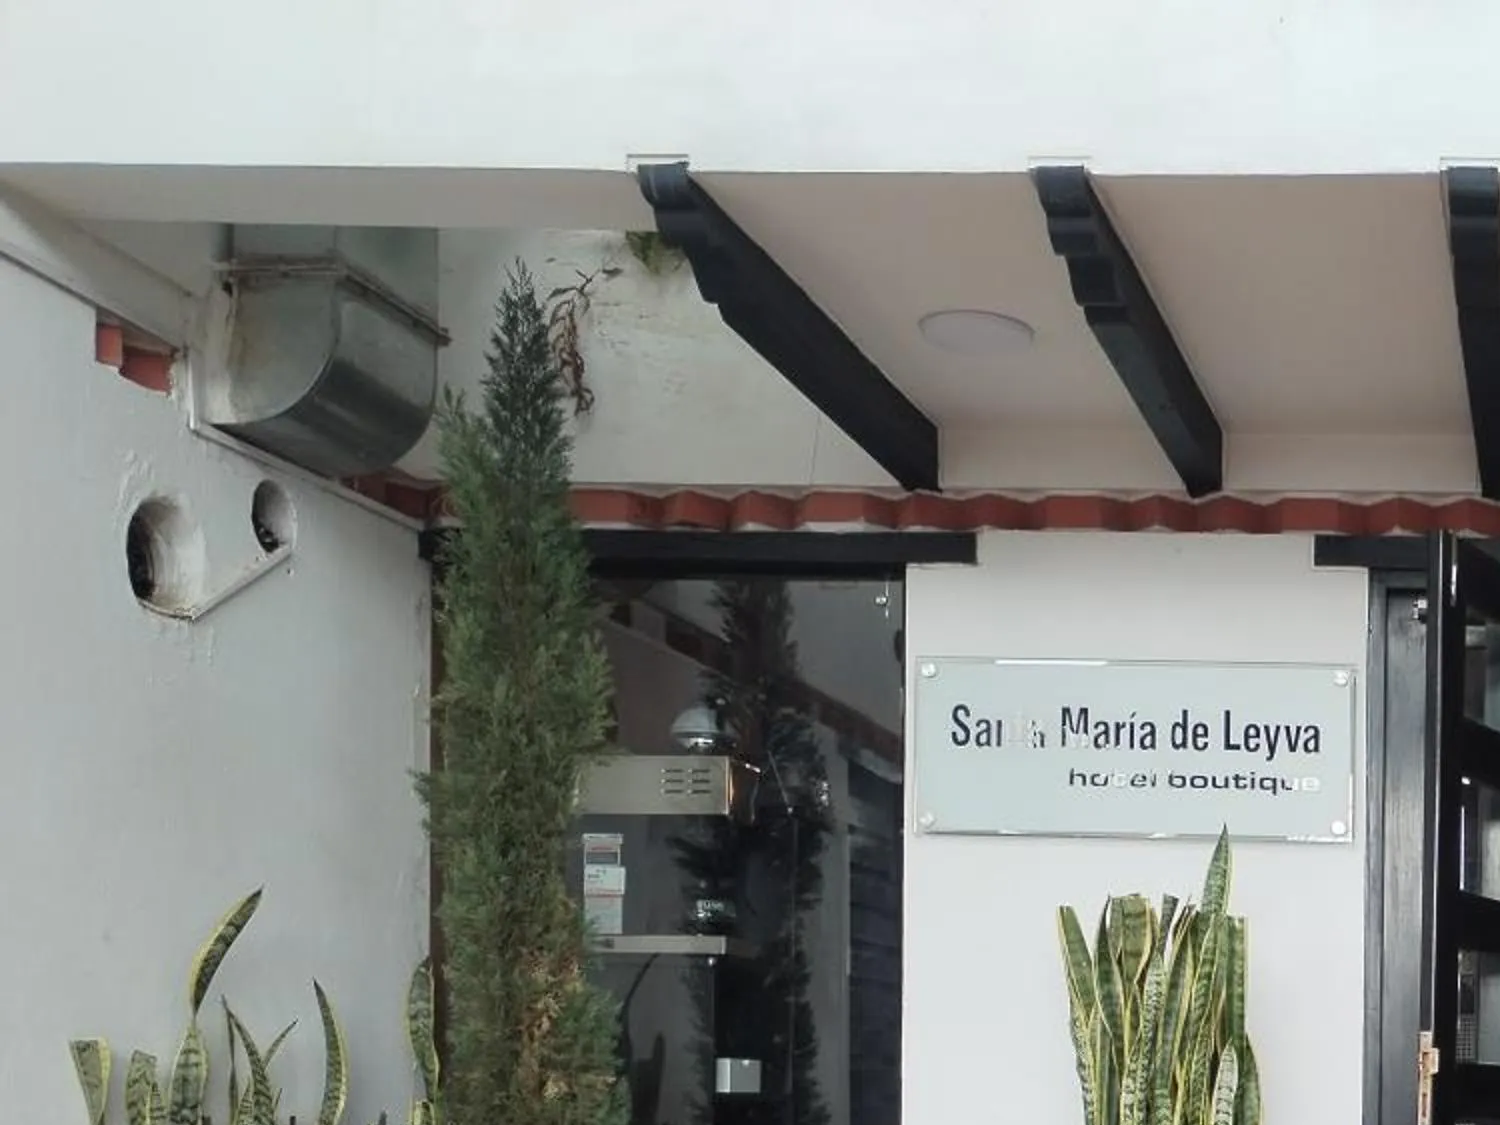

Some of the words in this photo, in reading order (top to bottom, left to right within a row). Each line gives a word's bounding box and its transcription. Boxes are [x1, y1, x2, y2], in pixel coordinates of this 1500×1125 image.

[951, 703, 1046, 749] Saa
[1060, 706, 1157, 750] María
[1171, 708, 1209, 751] de
[1224, 709, 1321, 762] Leyva
[1167, 770, 1321, 796] boutique
